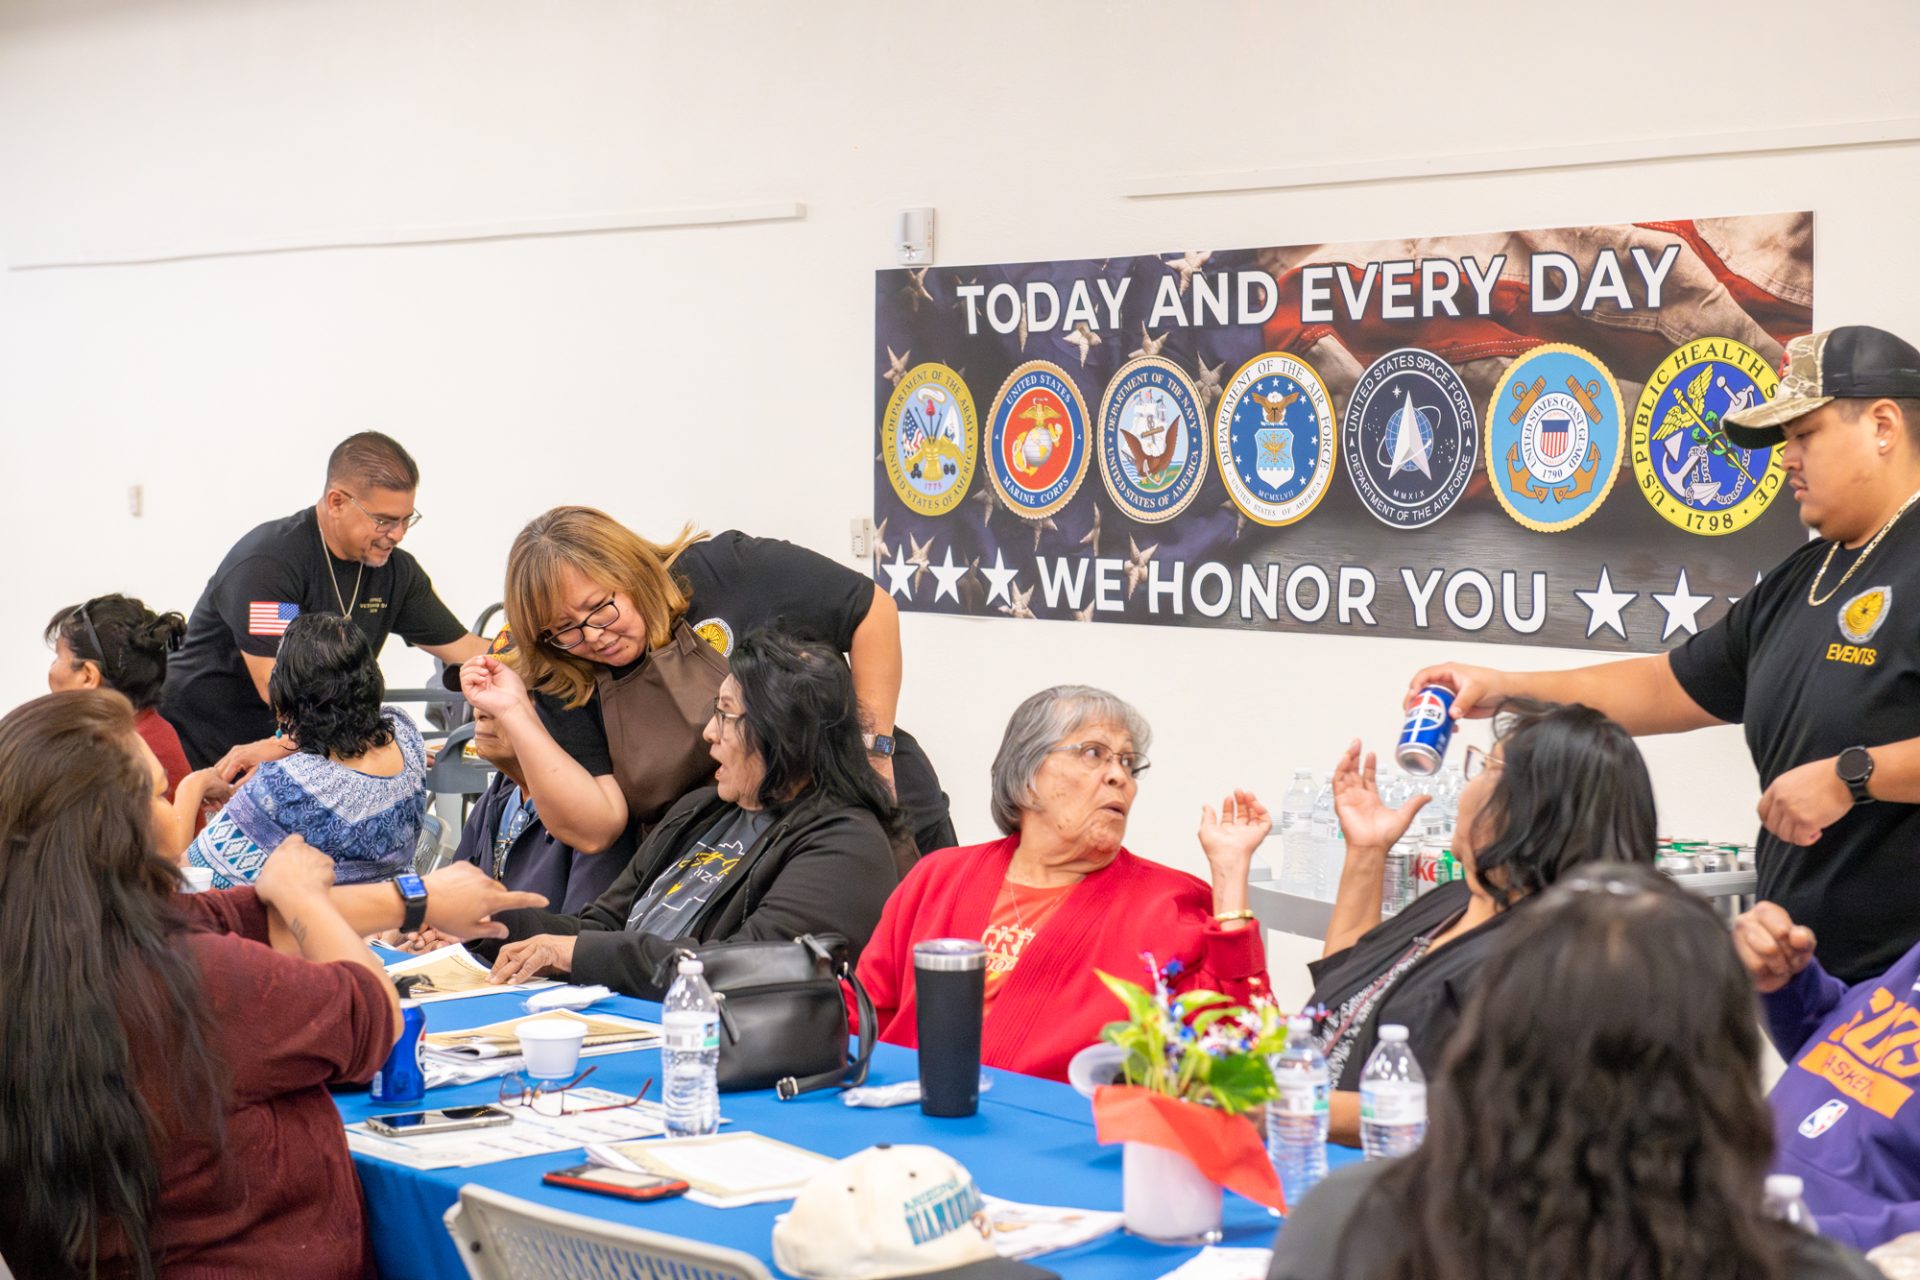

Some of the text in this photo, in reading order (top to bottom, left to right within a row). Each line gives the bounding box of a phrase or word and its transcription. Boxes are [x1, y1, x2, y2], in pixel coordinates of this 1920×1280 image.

[956, 244, 1681, 335] TODAY AND EVERY DAY
[1005, 373, 1072, 406] UNITED STATES
[1674, 341, 1766, 379] HEALTH
[888, 370, 975, 433] DEPARTMENT OF THE ARMY
[1108, 372, 1198, 433] DEPARTMENT OF THE NAVY
[1219, 359, 1333, 471] DEPARTMENT OF THE AIR FORCE
[1348, 355, 1472, 433] UNITED STATES SPACE FORCE
[1635, 368, 1670, 464] PUBLIC
[1523, 396, 1586, 469] UNITED STATES COAST GUARD
[887, 443, 974, 509] UNITED STATES OF AMERICA
[1002, 475, 1070, 505] MARINE CORPS
[1107, 447, 1199, 509] UNITED STATES OF AMERICA
[1231, 476, 1322, 517] UNITED STATES OF AMERICA
[1258, 489, 1294, 501] MCMXLVII
[1350, 453, 1471, 522] DEPARTMENT OF THE AIR FORCE
[1393, 488, 1425, 500] MMXIX
[1542, 469, 1563, 479] 1790
[1641, 466, 1666, 508] U.S.
[1685, 512, 1734, 532] 1798
[1036, 555, 1547, 633] WE HONOR YOU
[1826, 643, 1877, 666] EVENTS
